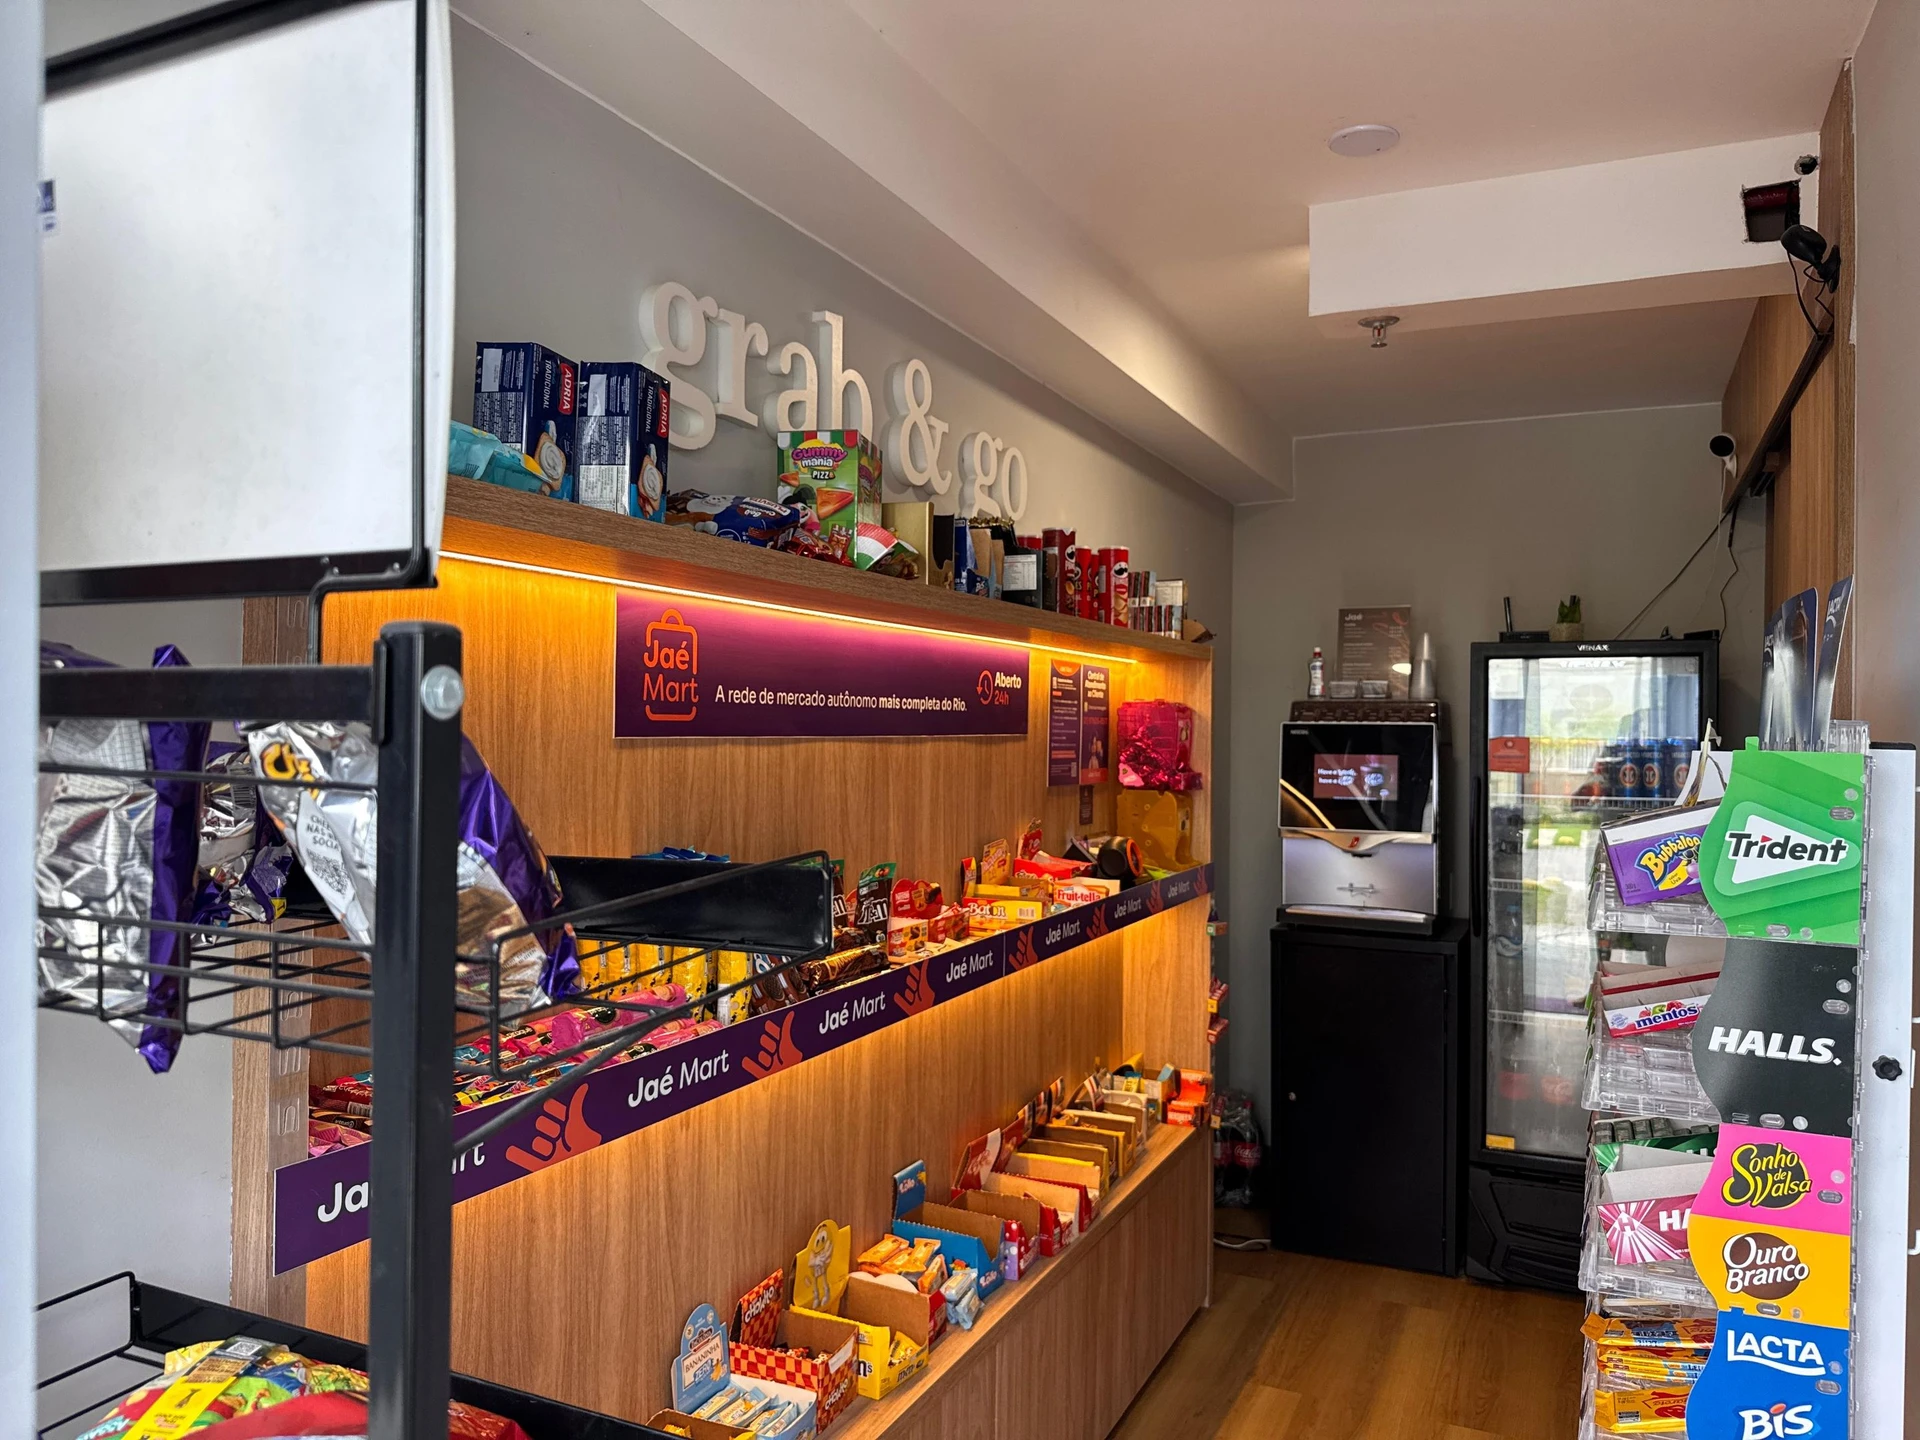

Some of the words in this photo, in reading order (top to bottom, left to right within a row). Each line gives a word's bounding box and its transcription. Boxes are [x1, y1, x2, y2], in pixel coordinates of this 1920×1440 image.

[543, 360, 552, 409] TRADICIONAL
[562, 368, 573, 411] ADRIA
[638, 281, 874, 451] grab
[887, 358, 952, 497] &
[960, 431, 1029, 523] go
[646, 385, 654, 433] TRADICIONAL
[660, 394, 669, 434] ADRIA
[802, 457, 833, 468] mania
[643, 639, 690, 671] Jaé
[643, 673, 699, 703] Mart
[994, 671, 1022, 690] Aberto
[714, 684, 726, 703] A
[728, 686, 757, 704] rede
[759, 687, 774, 705] de
[776, 689, 826, 707] mercado
[827, 691, 878, 709] autônomo
[878, 694, 900, 710] mais
[901, 695, 941, 713] completa
[941, 697, 952, 711] do
[952, 697, 968, 712] Rio.
[994, 690, 1010, 706] 24h
[312, 836, 339, 850] SOCIA
[1640, 835, 1701, 881] Bubbaloo
[1728, 831, 1848, 864] Trident
[1114, 902, 1127, 919] Jaé
[1127, 898, 1142, 915] Mart
[1045, 924, 1062, 945] Jaé
[1062, 919, 1081, 941] Mart
[946, 956, 968, 983] Jaé
[969, 949, 994, 974] Mart
[819, 1003, 850, 1035] Jaé
[852, 991, 886, 1022] Mart
[1635, 1005, 1698, 1028] mentos
[628, 1072, 674, 1107] Jaé
[679, 1049, 730, 1090] Mart
[1722, 1143, 1798, 1204] Sonho
[1751, 1170, 1812, 1207] Valsa
[1773, 1168, 1787, 1181] de
[317, 1181, 370, 1223] Ja
[1723, 1234, 1798, 1270] Ouro
[1726, 1262, 1810, 1294] Branco
[745, 1286, 775, 1323] CHOKITO
[685, 1342, 720, 1373] BANANINHA
[1727, 1329, 1827, 1377] LACTA
[694, 1360, 712, 1383] ZERO
